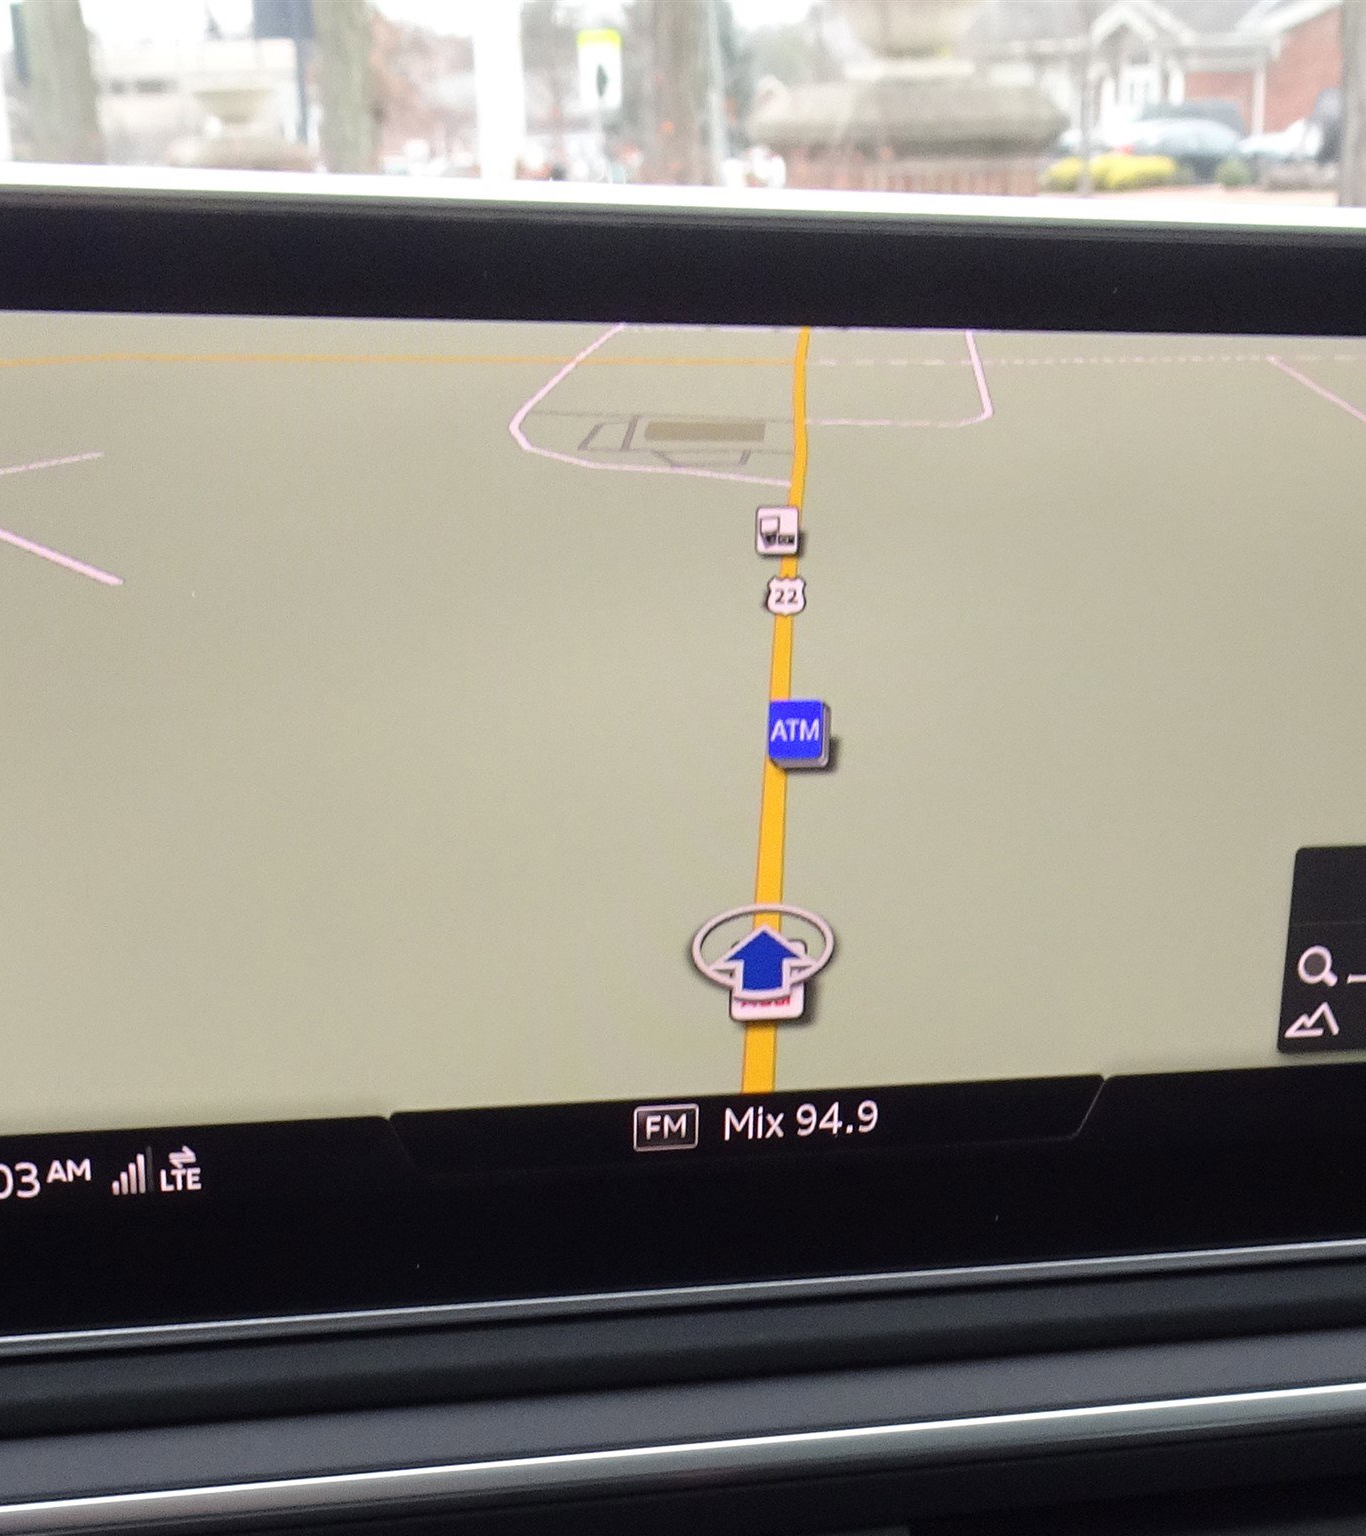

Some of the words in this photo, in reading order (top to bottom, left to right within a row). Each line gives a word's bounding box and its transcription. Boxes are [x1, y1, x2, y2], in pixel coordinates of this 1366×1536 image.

[774, 588, 799, 605] 22
[770, 717, 820, 743] ATM
[644, 1114, 688, 1141] FM
[723, 1105, 785, 1142] Mix
[795, 1100, 879, 1137] 94.9
[46, 1157, 93, 1184] AM
[159, 1166, 203, 1193] LTE
